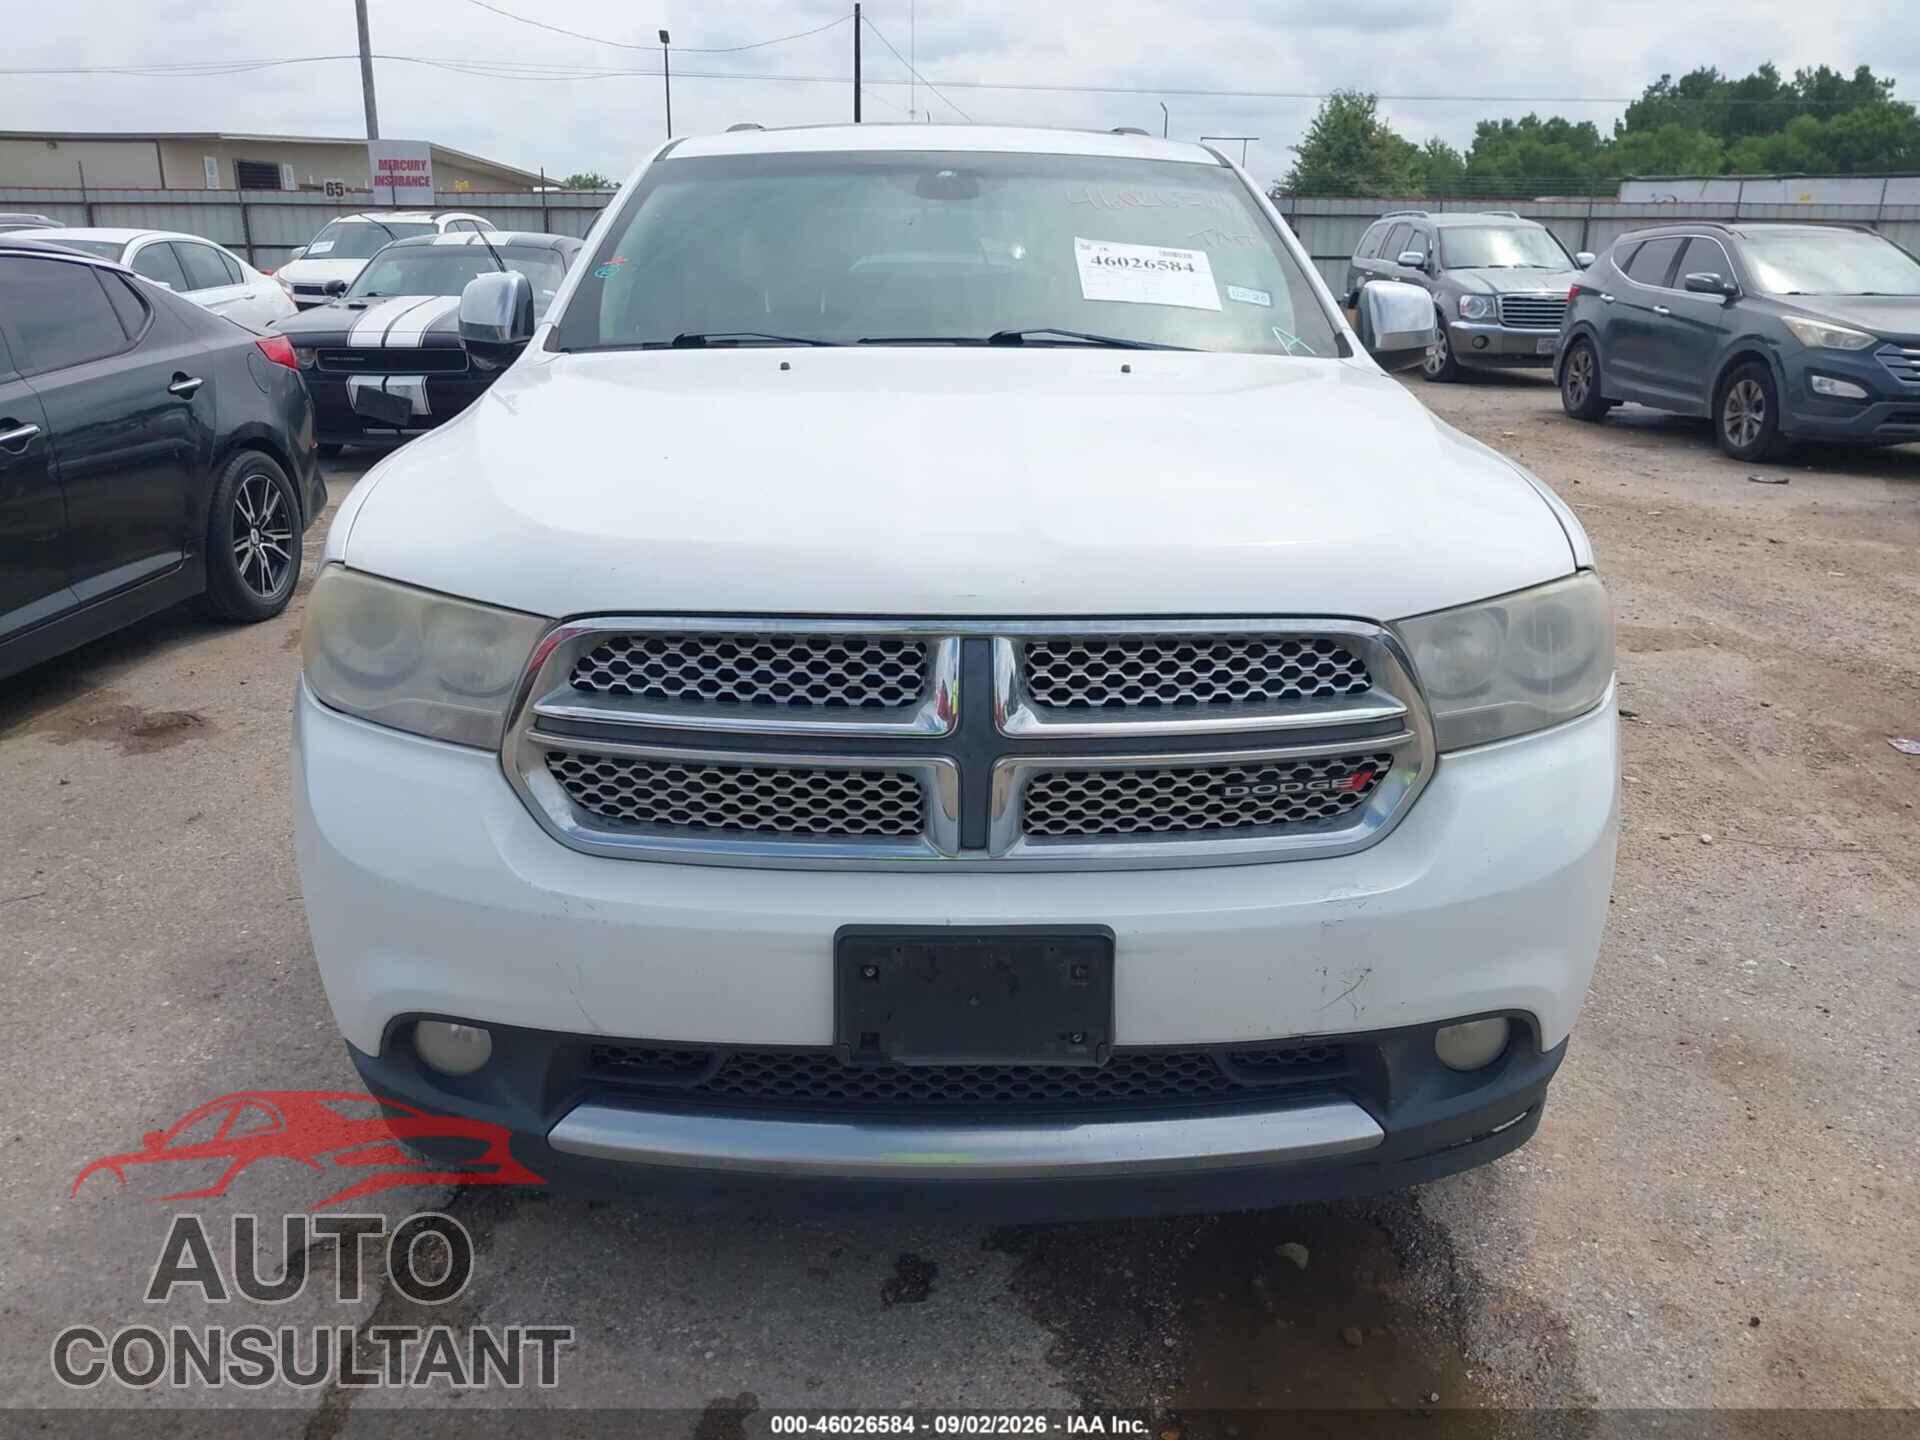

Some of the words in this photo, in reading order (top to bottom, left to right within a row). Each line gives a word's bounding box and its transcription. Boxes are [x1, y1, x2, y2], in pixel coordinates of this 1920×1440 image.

[378, 159, 427, 171] MERCURY
[325, 181, 345, 197] 65
[374, 175, 431, 188] INSURANCE
[1090, 255, 1195, 273] 46026584
[1224, 777, 1353, 796] DODGE
